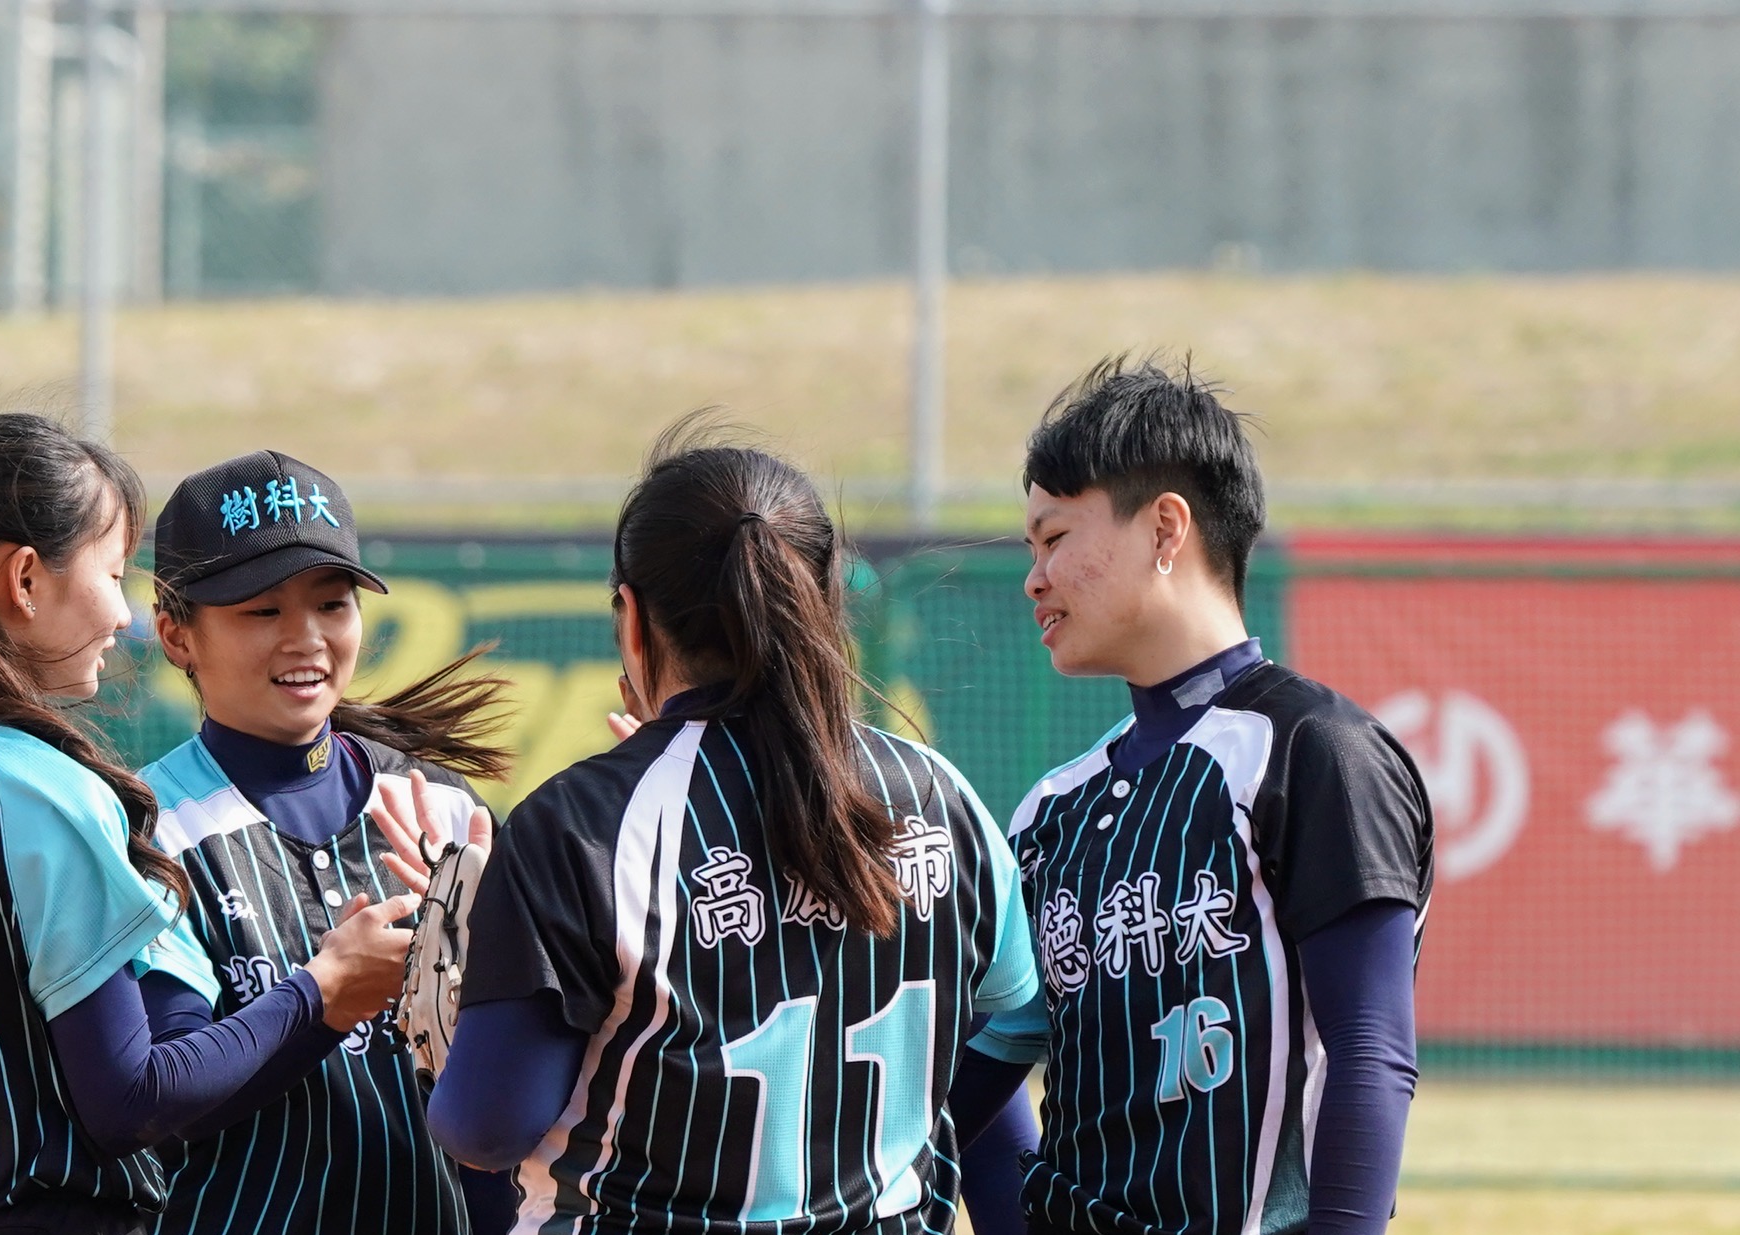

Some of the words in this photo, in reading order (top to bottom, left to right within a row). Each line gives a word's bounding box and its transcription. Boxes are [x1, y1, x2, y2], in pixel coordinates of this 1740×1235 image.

[220, 476, 340, 536] 樹科大
[692, 815, 955, 948] 高市
[720, 979, 936, 1223] 11
[1150, 995, 1234, 1103] 16
